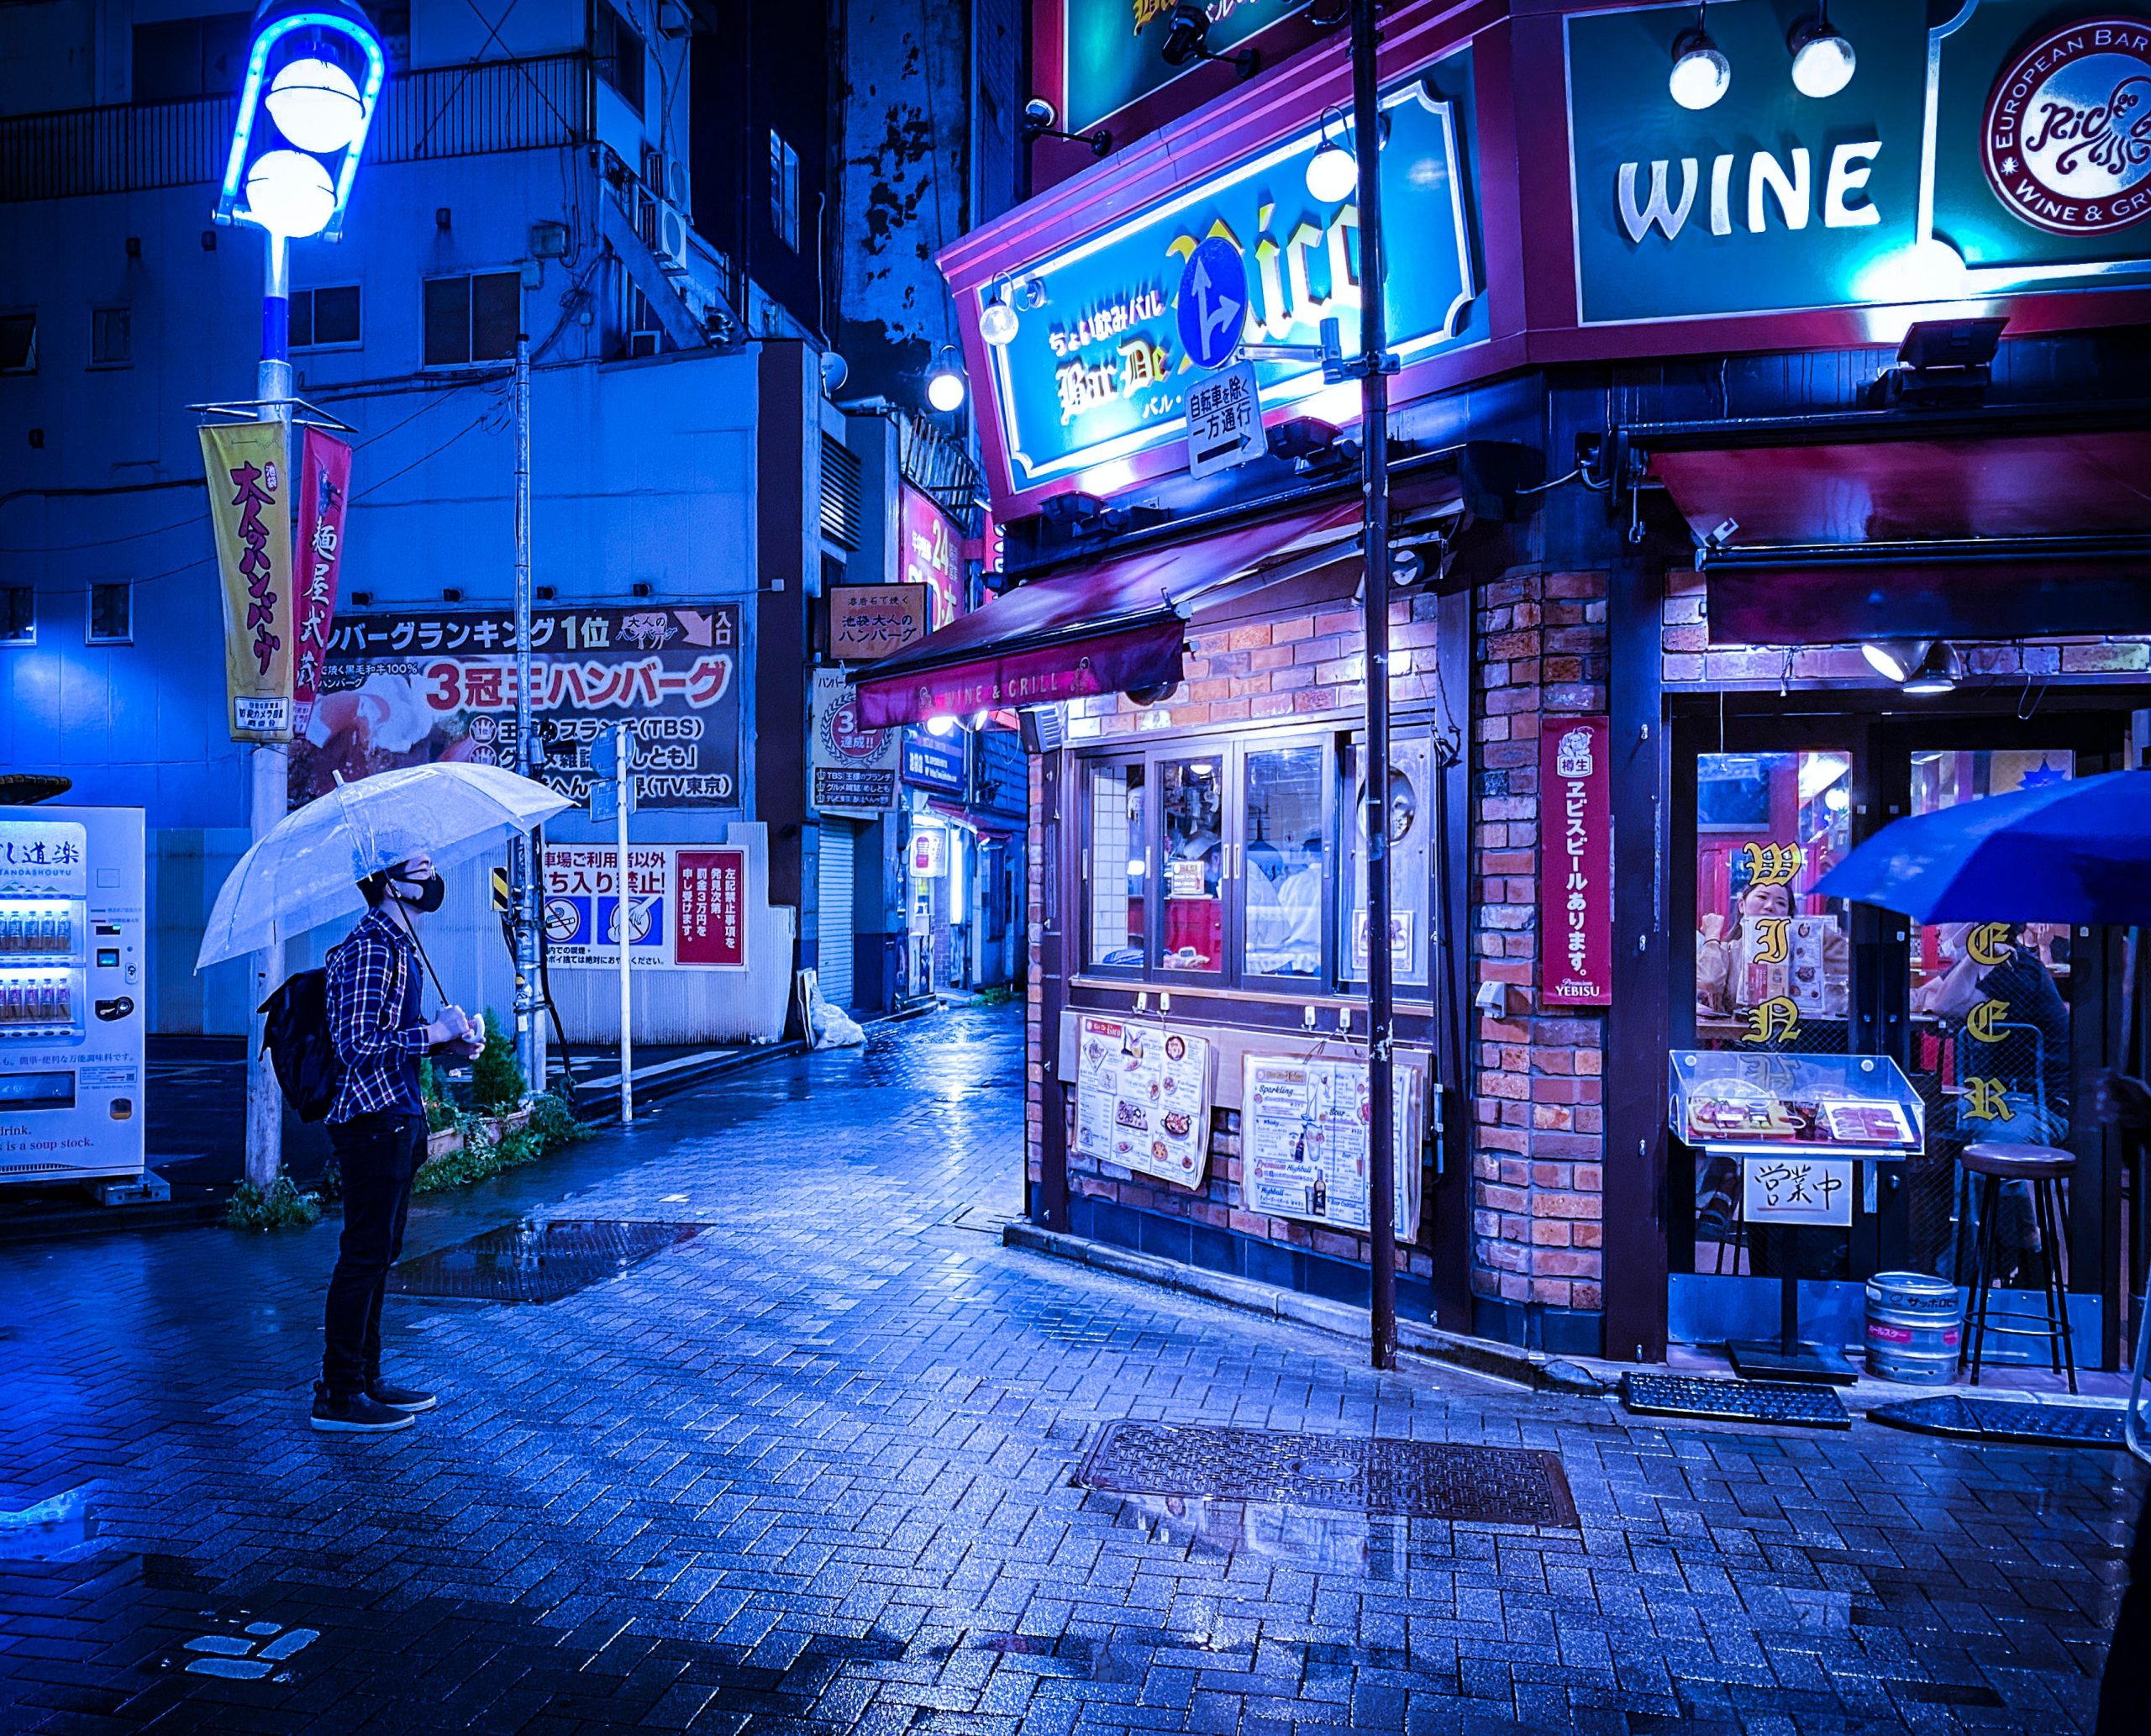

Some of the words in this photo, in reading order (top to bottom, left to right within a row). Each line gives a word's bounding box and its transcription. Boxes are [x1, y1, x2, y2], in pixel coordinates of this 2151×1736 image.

[1618, 139, 1883, 244] WINE
[2015, 177, 2079, 221] WINE
[2085, 205, 2102, 221] &
[1190, 375, 1249, 418] 自転車を除く
[1192, 400, 1251, 440] 一方通行
[932, 518, 949, 576] 24
[229, 460, 281, 676] 大人のハンバーグ
[628, 616, 665, 628] 大人の
[714, 611, 732, 645] 入口
[838, 627, 917, 643] ハンバーグ
[945, 686, 983, 706] WINE
[991, 687, 1001, 701] &
[1007, 671, 1059, 698] GRILL
[827, 771, 843, 780] TBS
[1562, 758, 1589, 773] 樽生
[0, 840, 80, 865] し道楽
[1565, 781, 1588, 976] ヱビスビールあります。
[1555, 985, 1600, 997] YEBISU
[6, 1140, 16, 1151] is
[19, 1142, 26, 1150] a
[30, 1140, 57, 1152] soup
[60, 1137, 95, 1149] stock.
[1754, 1162, 1843, 1211] 営業中
